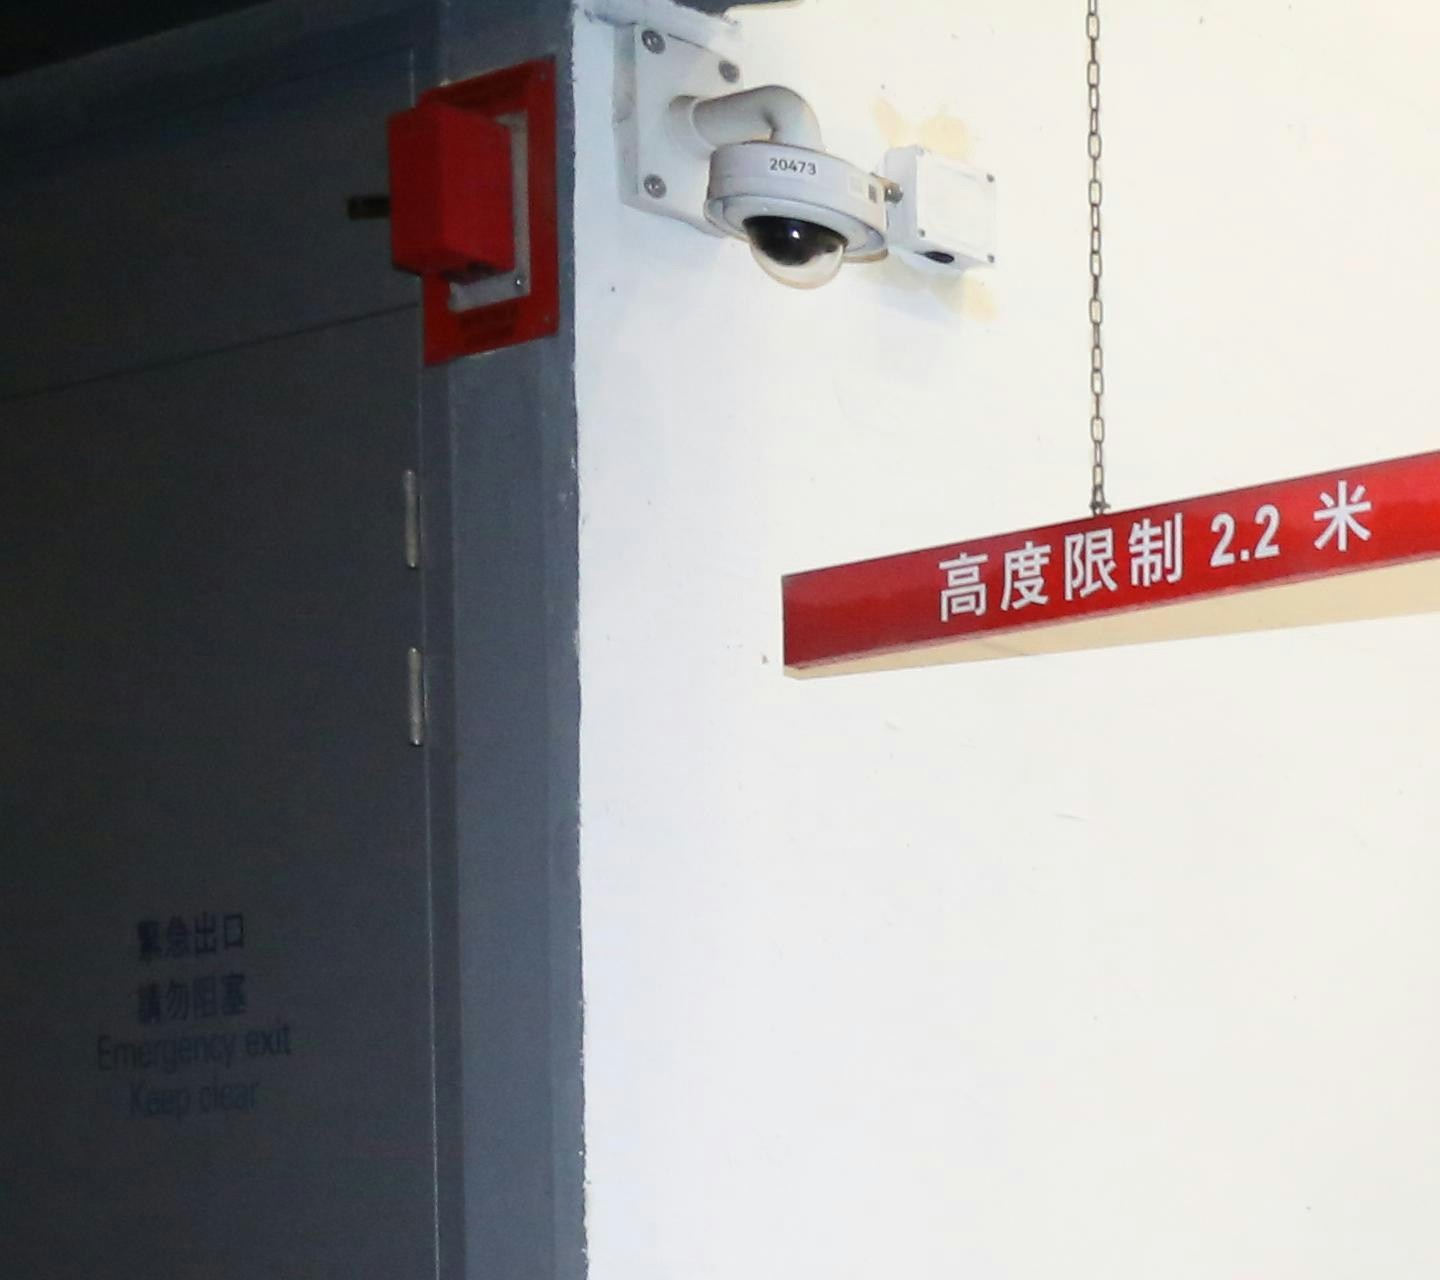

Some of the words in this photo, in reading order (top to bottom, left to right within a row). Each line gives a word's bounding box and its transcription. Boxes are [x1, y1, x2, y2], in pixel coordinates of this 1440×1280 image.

[768, 157, 817, 176] 20473
[938, 511, 1184, 622] 高度限制
[1209, 503, 1281, 568] 2.2
[1313, 480, 1372, 552] 米
[137, 911, 245, 961] 緊急出口
[97, 1032, 237, 1075] Emergency
[245, 1023, 292, 1058] exit
[129, 1079, 191, 1122] Keep
[199, 1074, 260, 1114] clear
